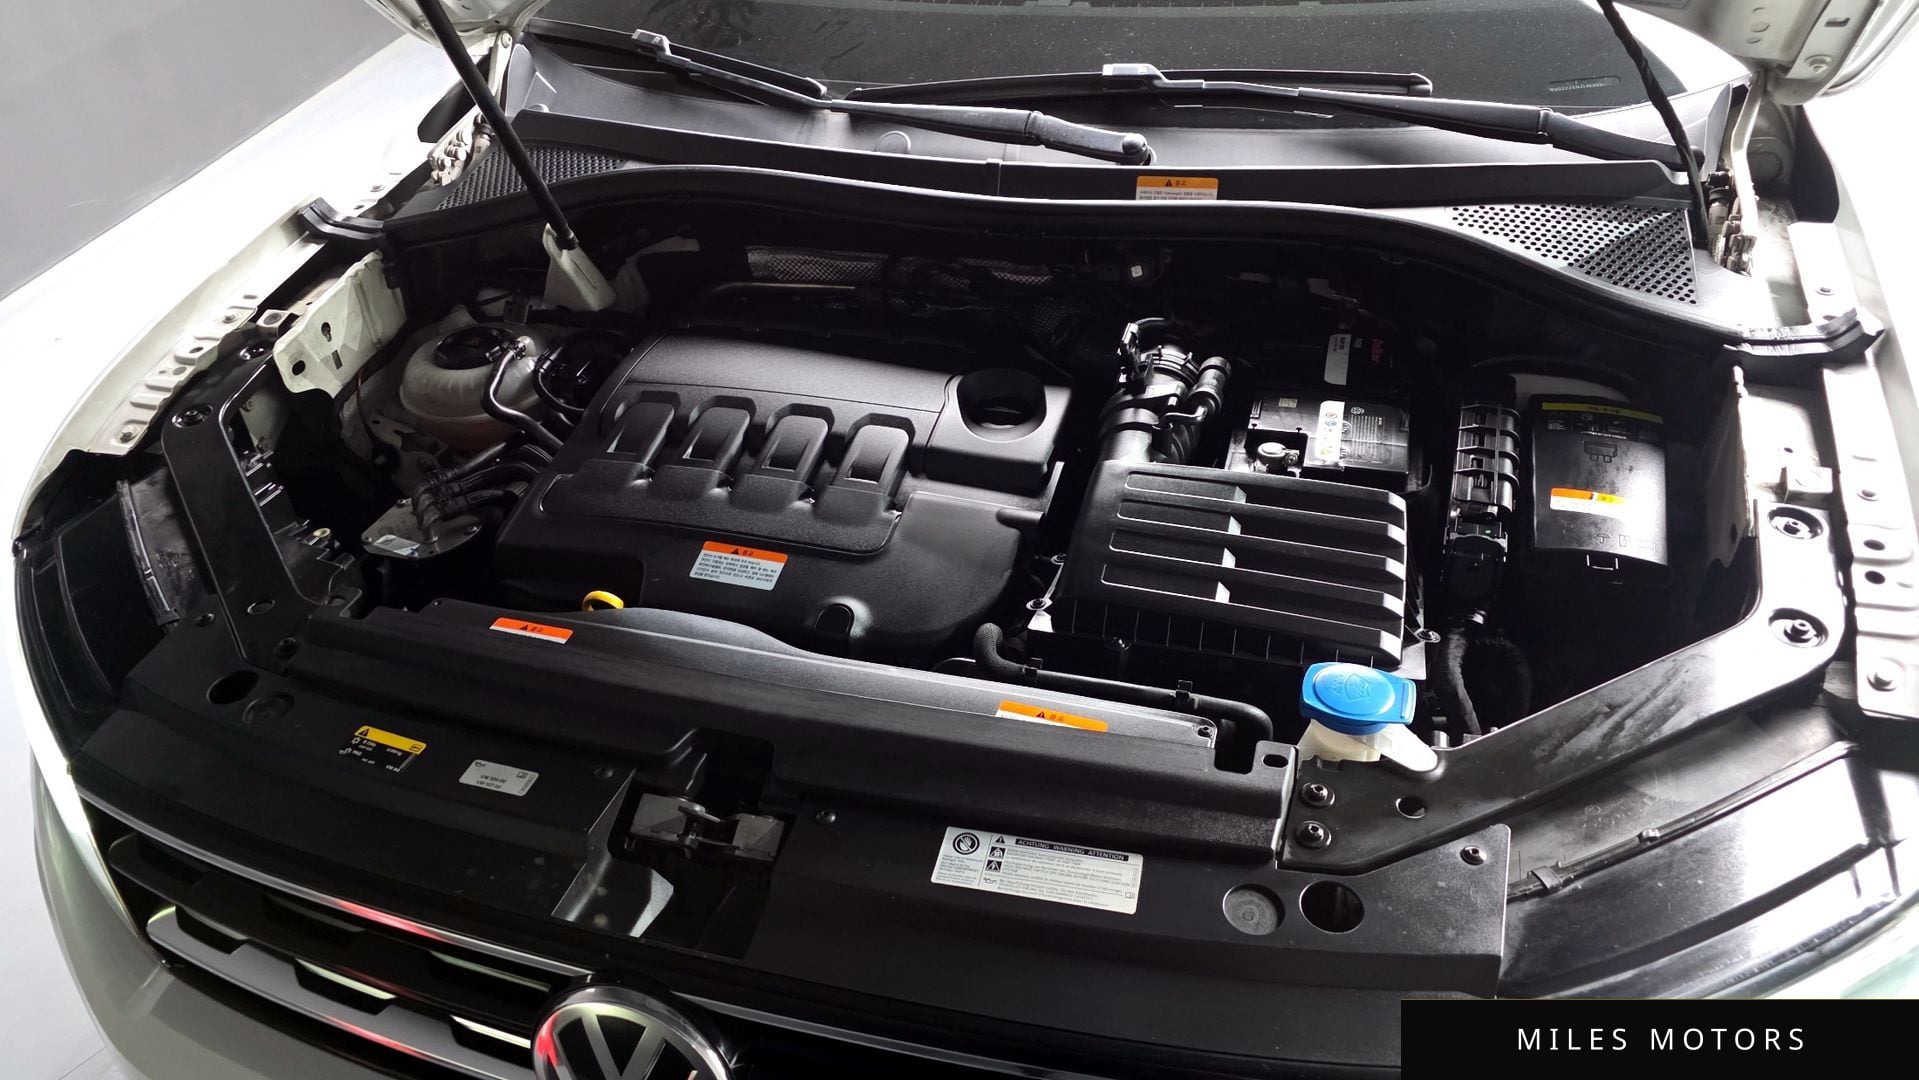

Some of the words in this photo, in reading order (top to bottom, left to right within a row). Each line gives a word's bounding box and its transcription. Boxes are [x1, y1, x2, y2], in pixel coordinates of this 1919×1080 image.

[1017, 839, 1050, 849] ACHTUNG
[1053, 845, 1085, 854] WARNING
[1088, 850, 1125, 860] ATTENTION
